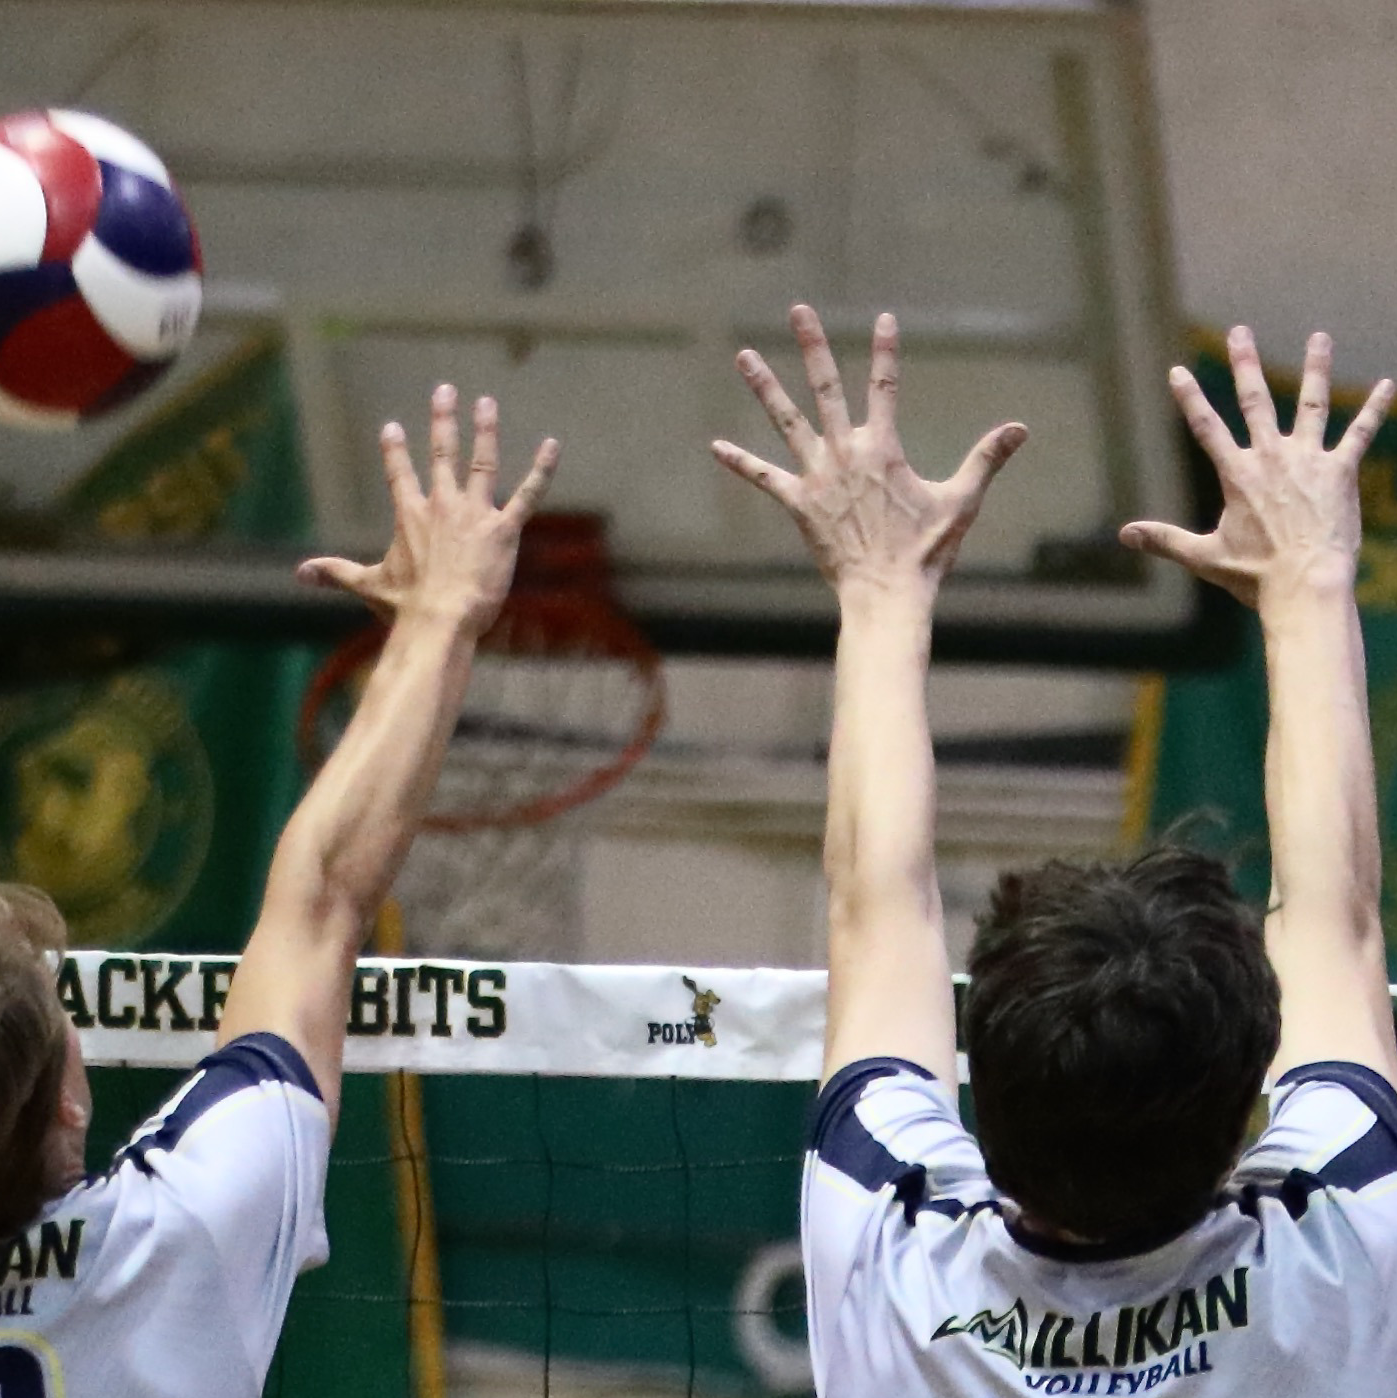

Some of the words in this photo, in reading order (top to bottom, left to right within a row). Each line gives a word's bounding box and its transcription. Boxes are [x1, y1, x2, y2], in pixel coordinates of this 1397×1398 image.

[647, 1020, 698, 1045] POLY
[930, 1266, 1250, 1370] MILLIKAN
[1024, 1340, 1214, 1396] VOLLEYBALL
